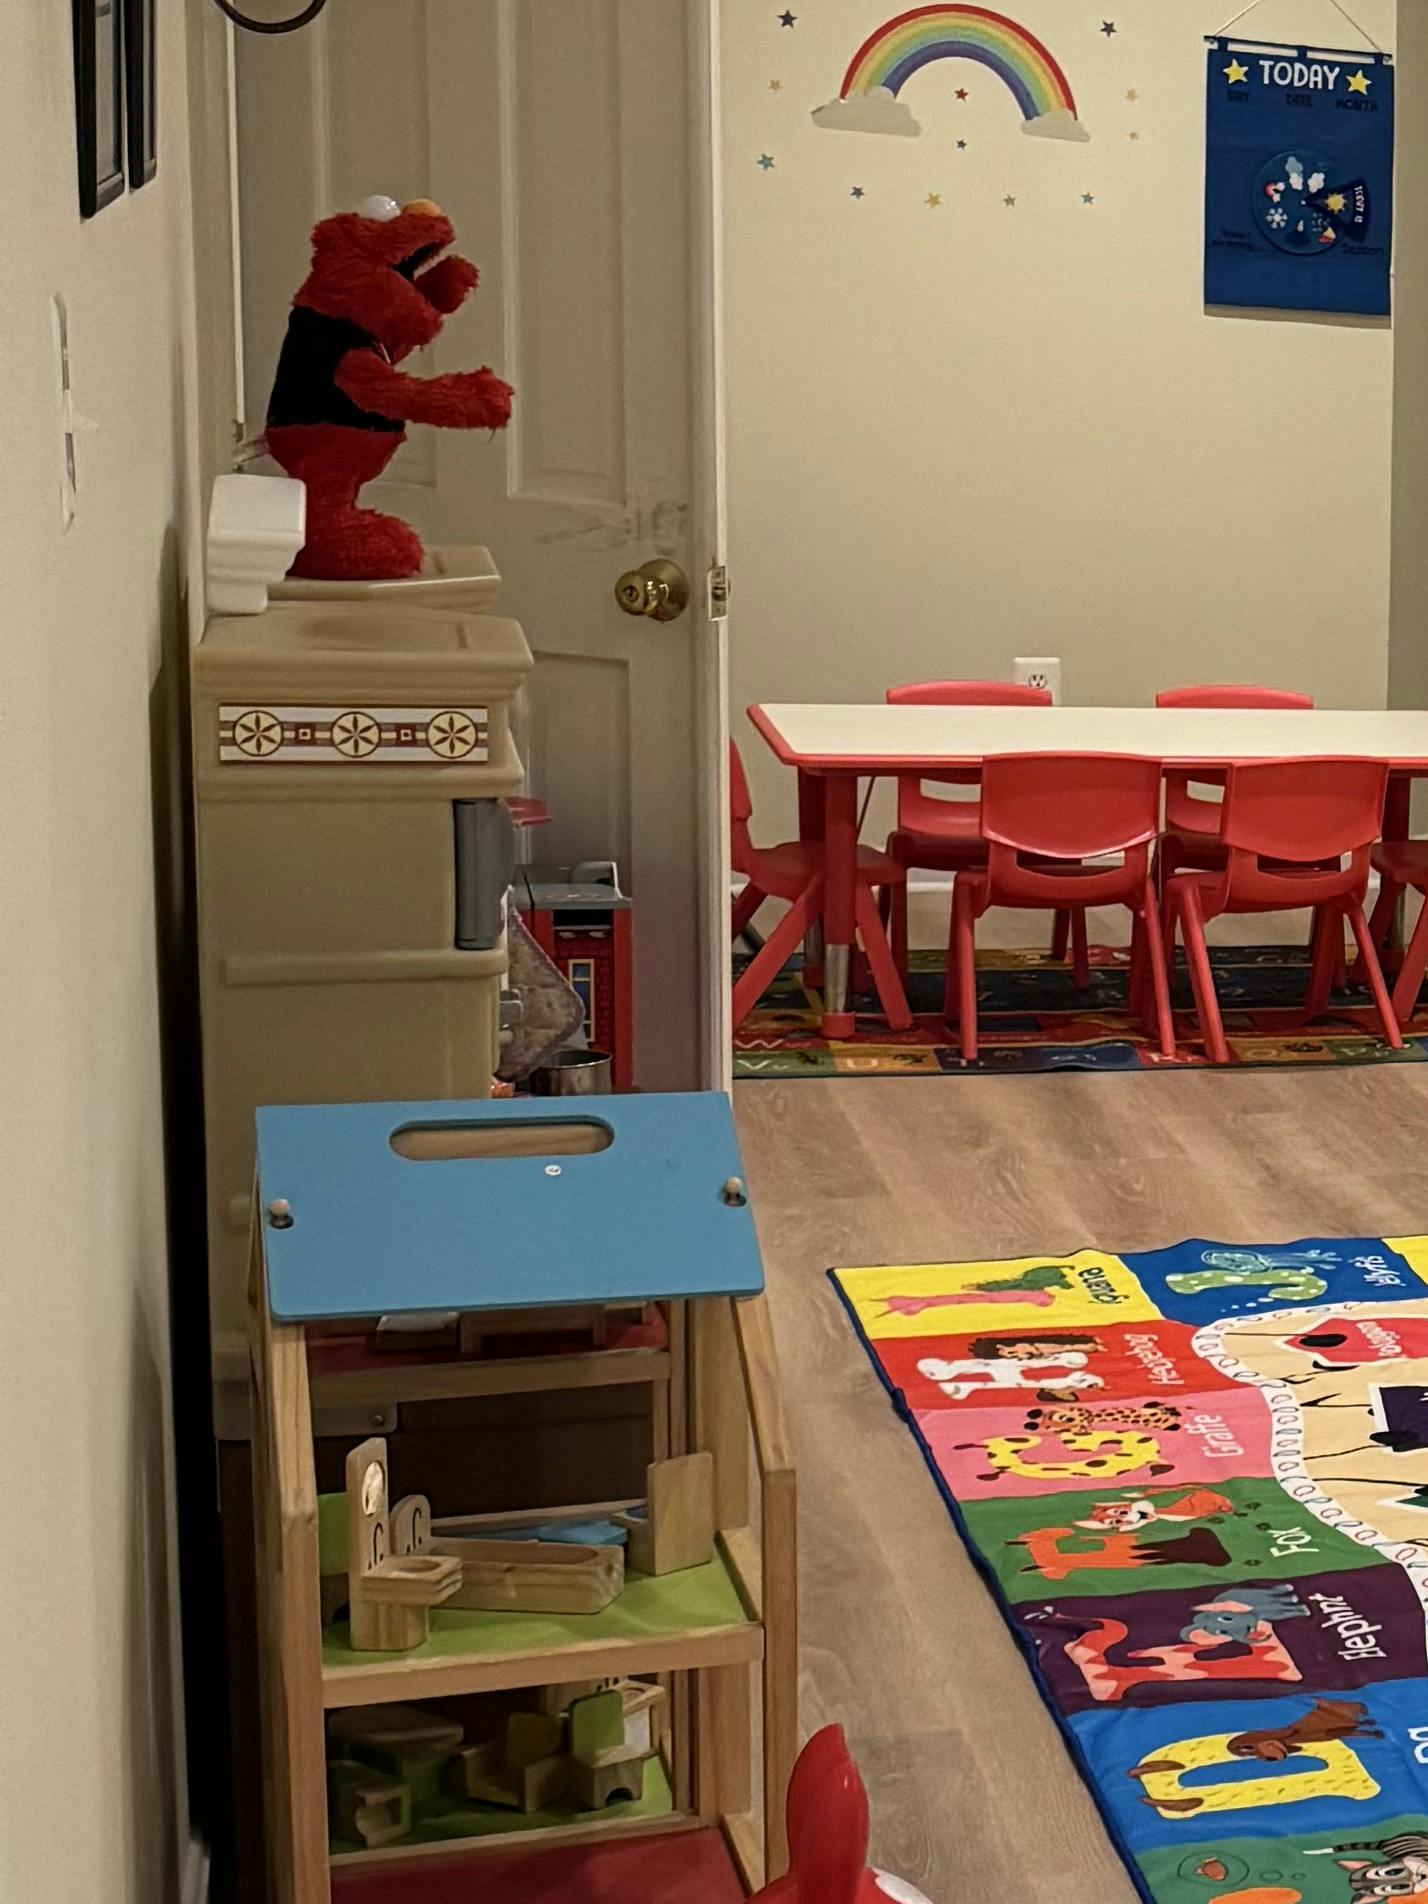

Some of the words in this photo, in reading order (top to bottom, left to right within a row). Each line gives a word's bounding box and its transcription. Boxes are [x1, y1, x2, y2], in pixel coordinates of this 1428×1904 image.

[1259, 60, 1340, 91] TODAY
[984, 1427, 1165, 1478] G
[1199, 1413, 1245, 1457] Giraffe
[1017, 1526, 1231, 1579] F
[1267, 1526, 1319, 1556] Fox
[1139, 1733, 1382, 1821] D
